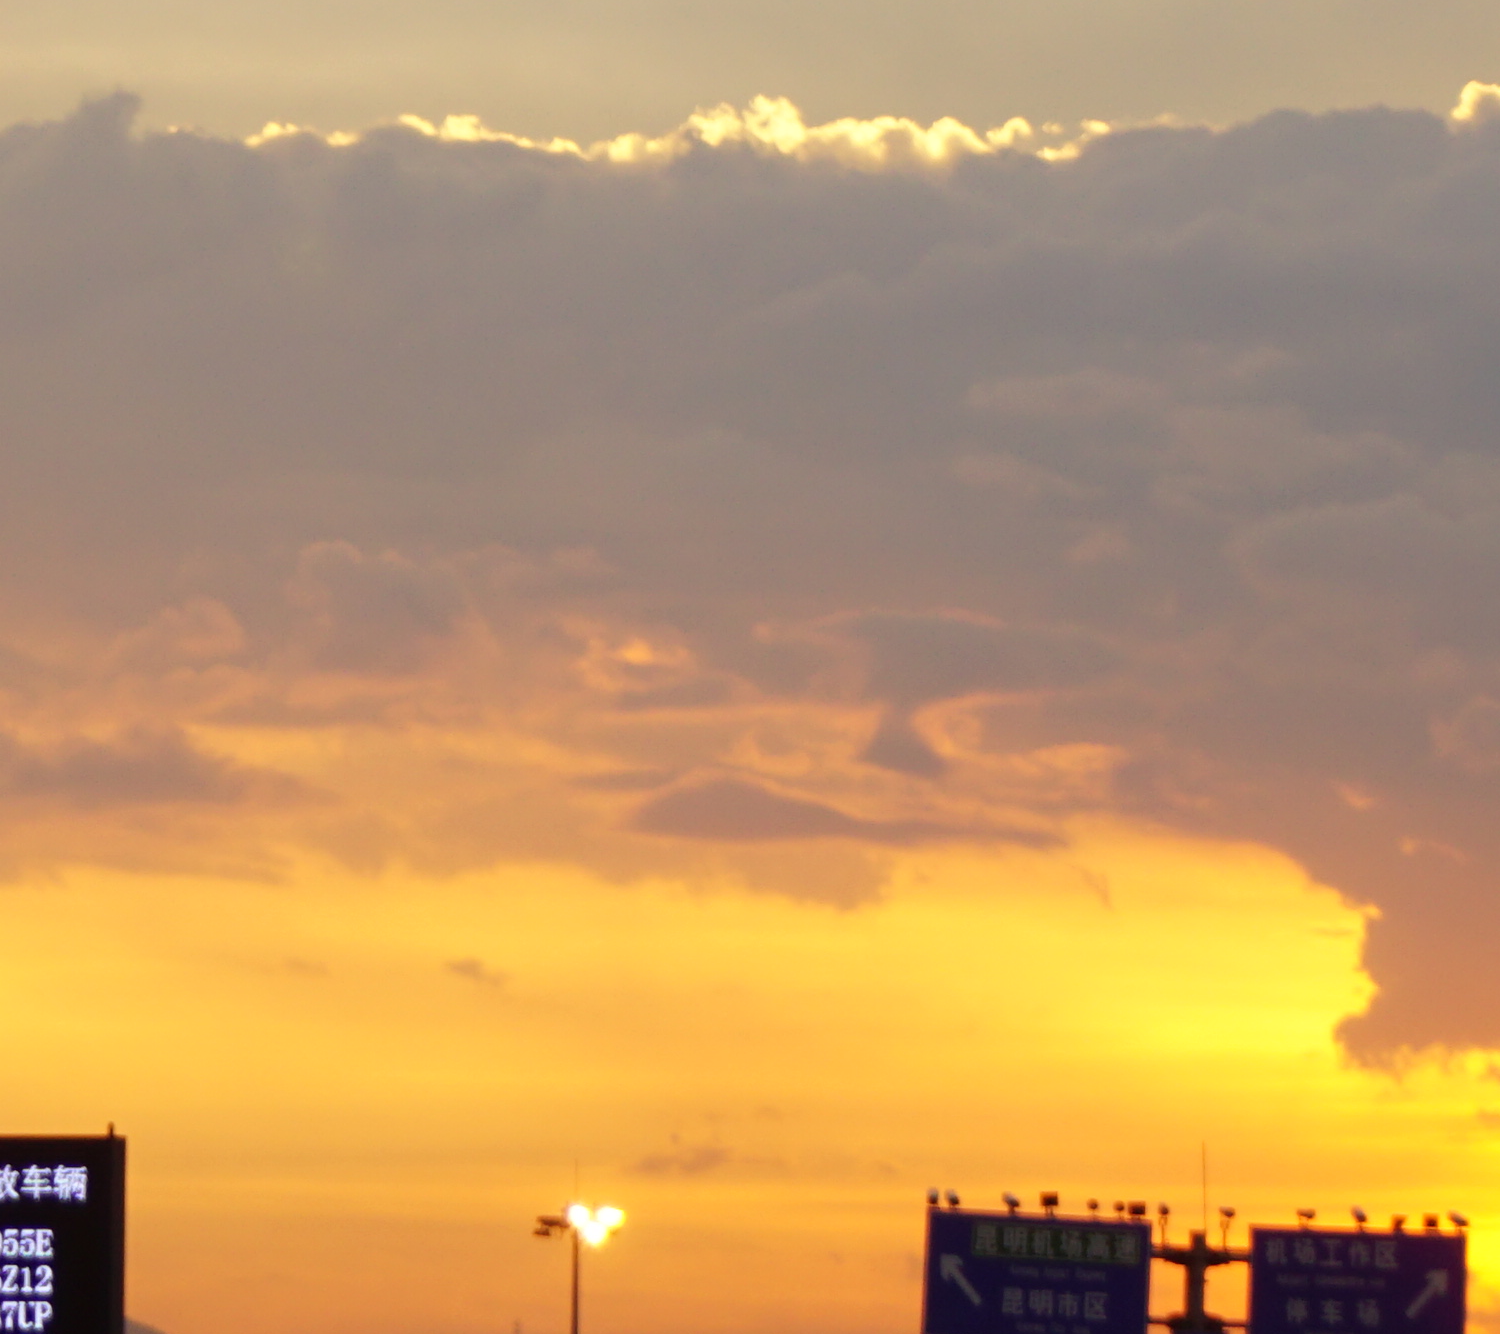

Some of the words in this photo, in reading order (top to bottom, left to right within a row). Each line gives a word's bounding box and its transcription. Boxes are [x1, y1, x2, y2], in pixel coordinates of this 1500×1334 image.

[975, 1224, 1137, 1265] 昆明机场高速
[1265, 1238, 1400, 1270] 机场工作区
[1001, 1287, 1108, 1322] 昆明市区
[1285, 1297, 1381, 1327] 停车场
